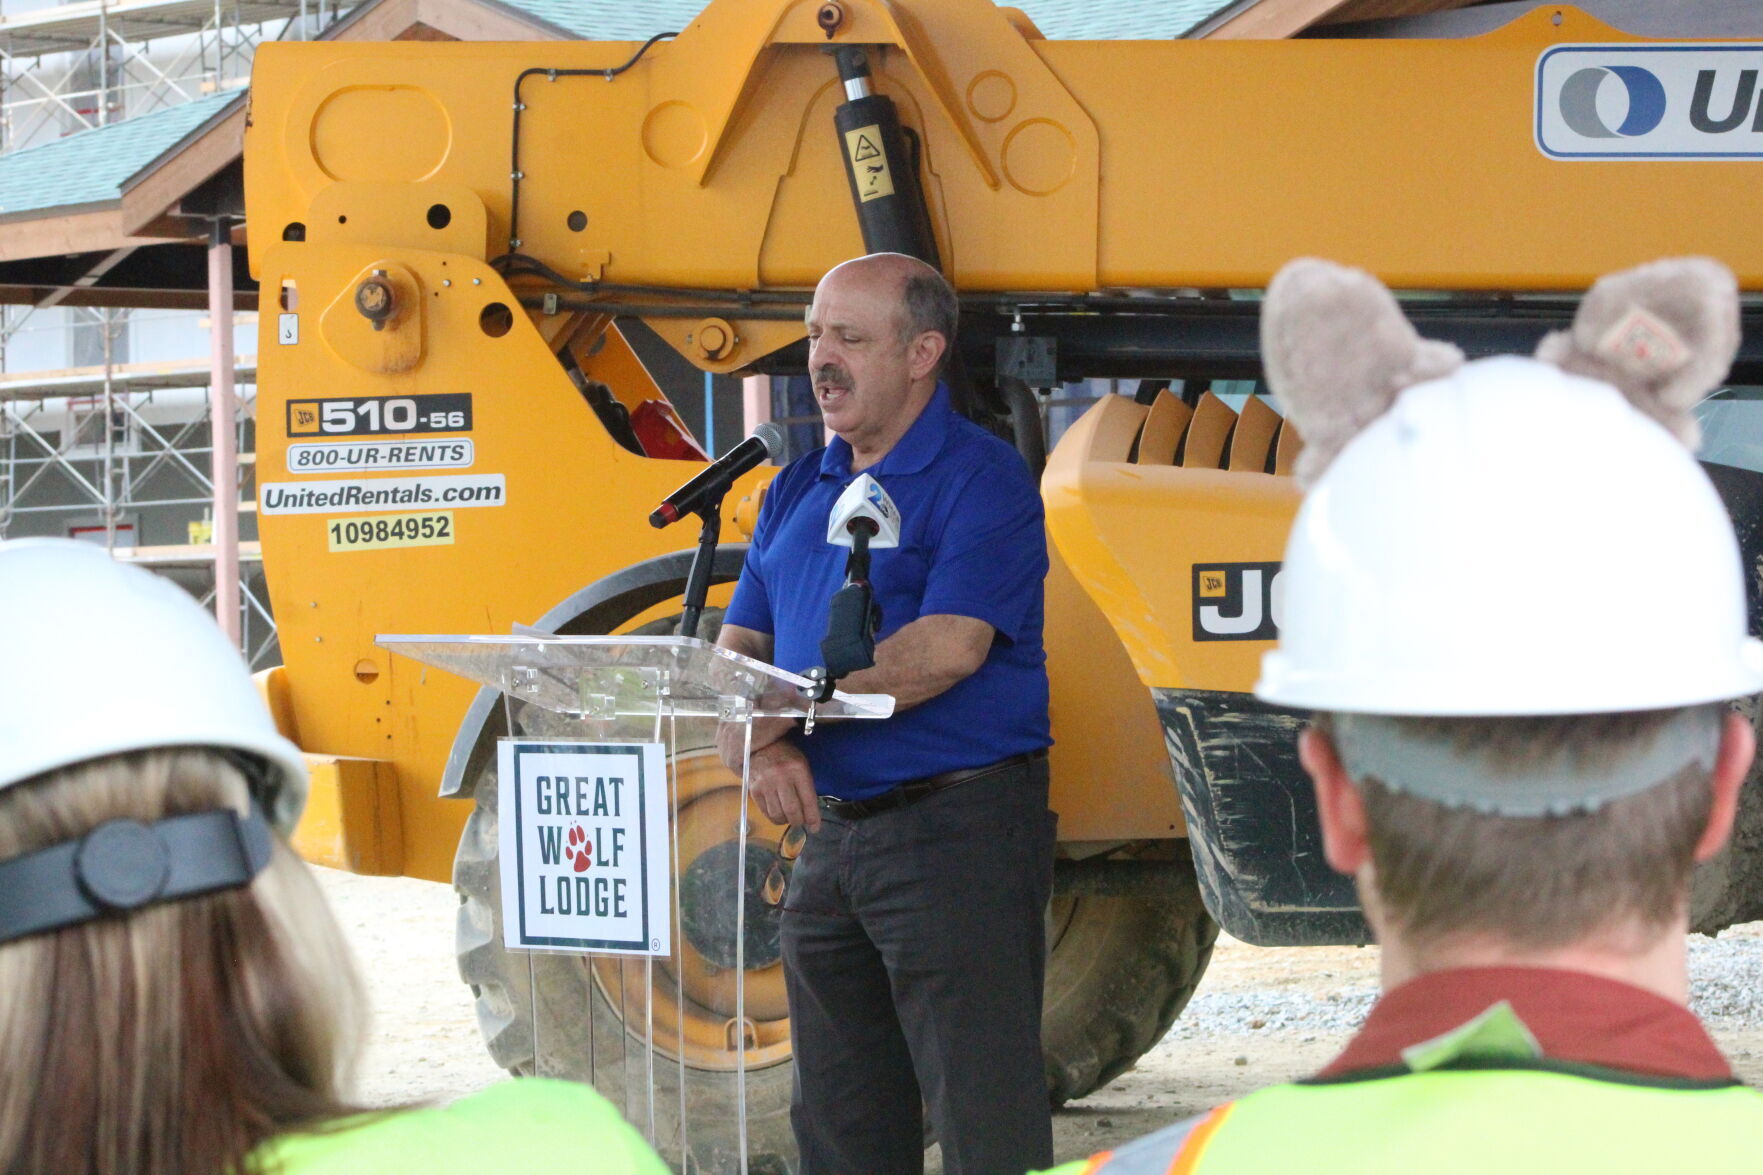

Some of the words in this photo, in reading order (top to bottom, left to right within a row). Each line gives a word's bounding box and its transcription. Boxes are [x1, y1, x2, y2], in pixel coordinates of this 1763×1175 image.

[1689, 69, 1763, 133] U
[322, 399, 465, 432] 510-56
[297, 445, 465, 466] 800-UR-RENTS
[265, 483, 501, 508] UnitedRentals.com
[331, 516, 450, 544] 10984952
[1199, 569, 1284, 634] J
[536, 776, 624, 817] GREAT
[537, 826, 626, 867] WLF
[539, 875, 628, 918] LODGE
